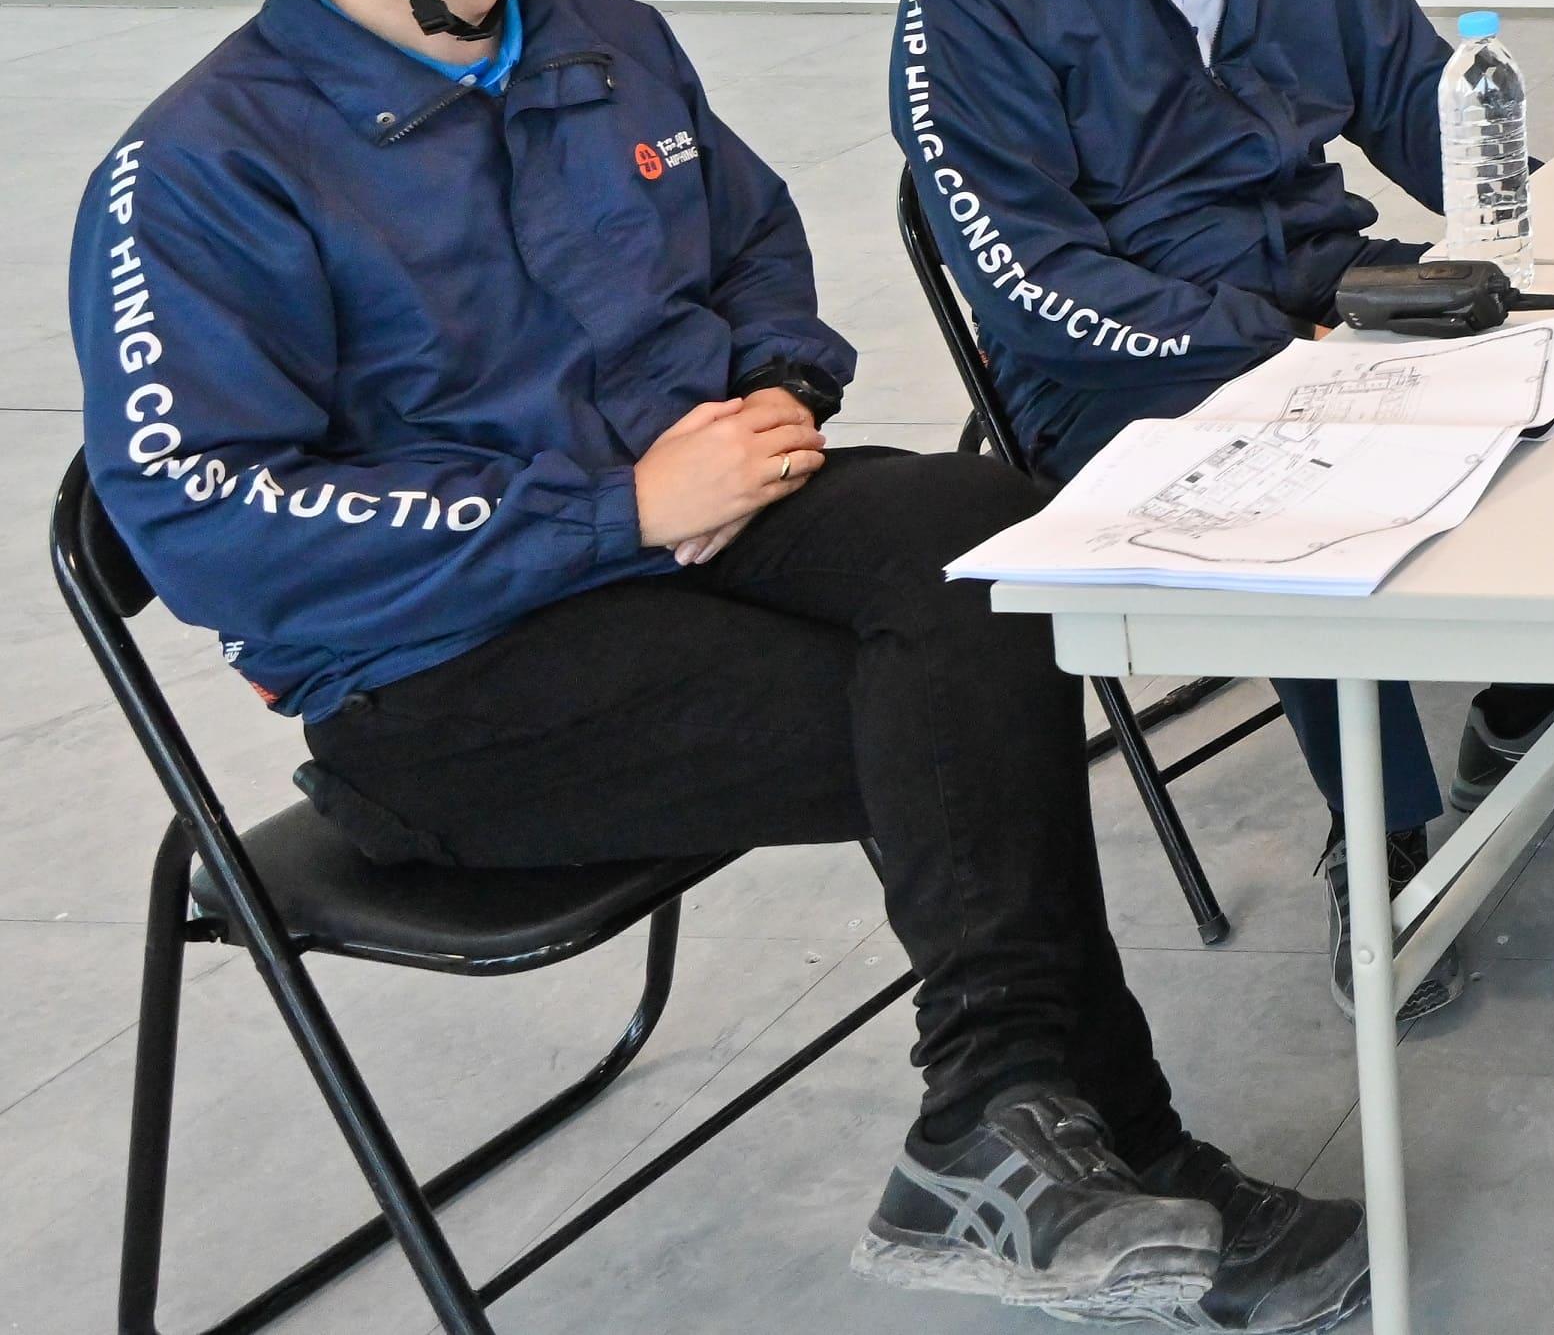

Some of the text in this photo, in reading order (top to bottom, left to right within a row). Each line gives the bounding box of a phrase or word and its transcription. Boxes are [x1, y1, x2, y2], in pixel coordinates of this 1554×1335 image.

[108, 140, 502, 532] HIP HING CONSRUCTIO
[904, 65, 945, 163] HING
[934, 167, 1191, 358] CONSTRUCTION
